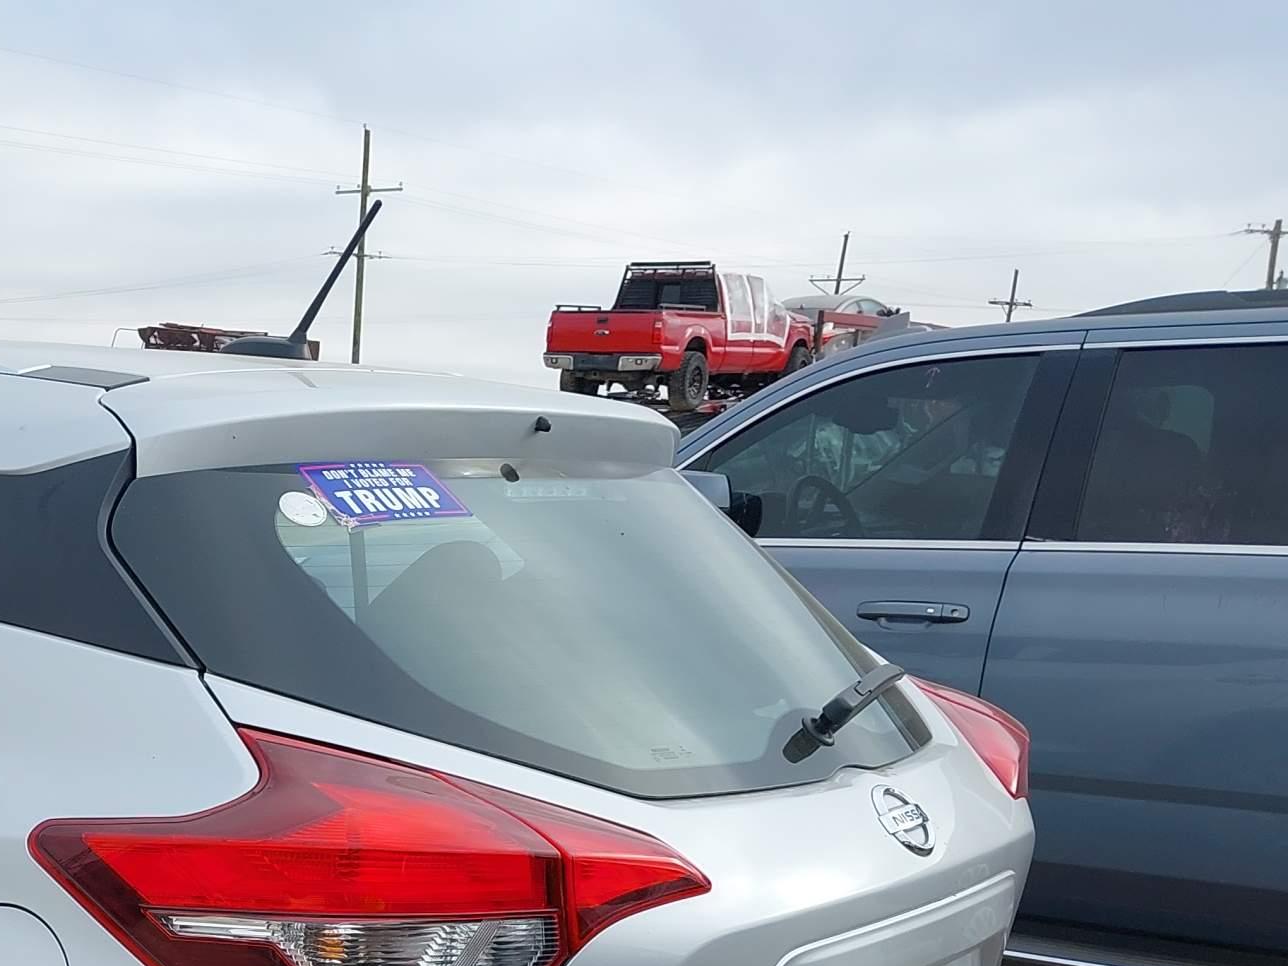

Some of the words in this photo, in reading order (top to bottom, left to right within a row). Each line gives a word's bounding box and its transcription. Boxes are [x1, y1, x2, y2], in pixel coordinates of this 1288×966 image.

[322, 469, 357, 480] DON'T
[358, 468, 397, 479] BLAME
[396, 468, 416, 477] ME
[352, 478, 389, 488] VOTED
[388, 477, 413, 487] FOR
[334, 486, 441, 514] TRUMP
[892, 806, 924, 827] NISS
